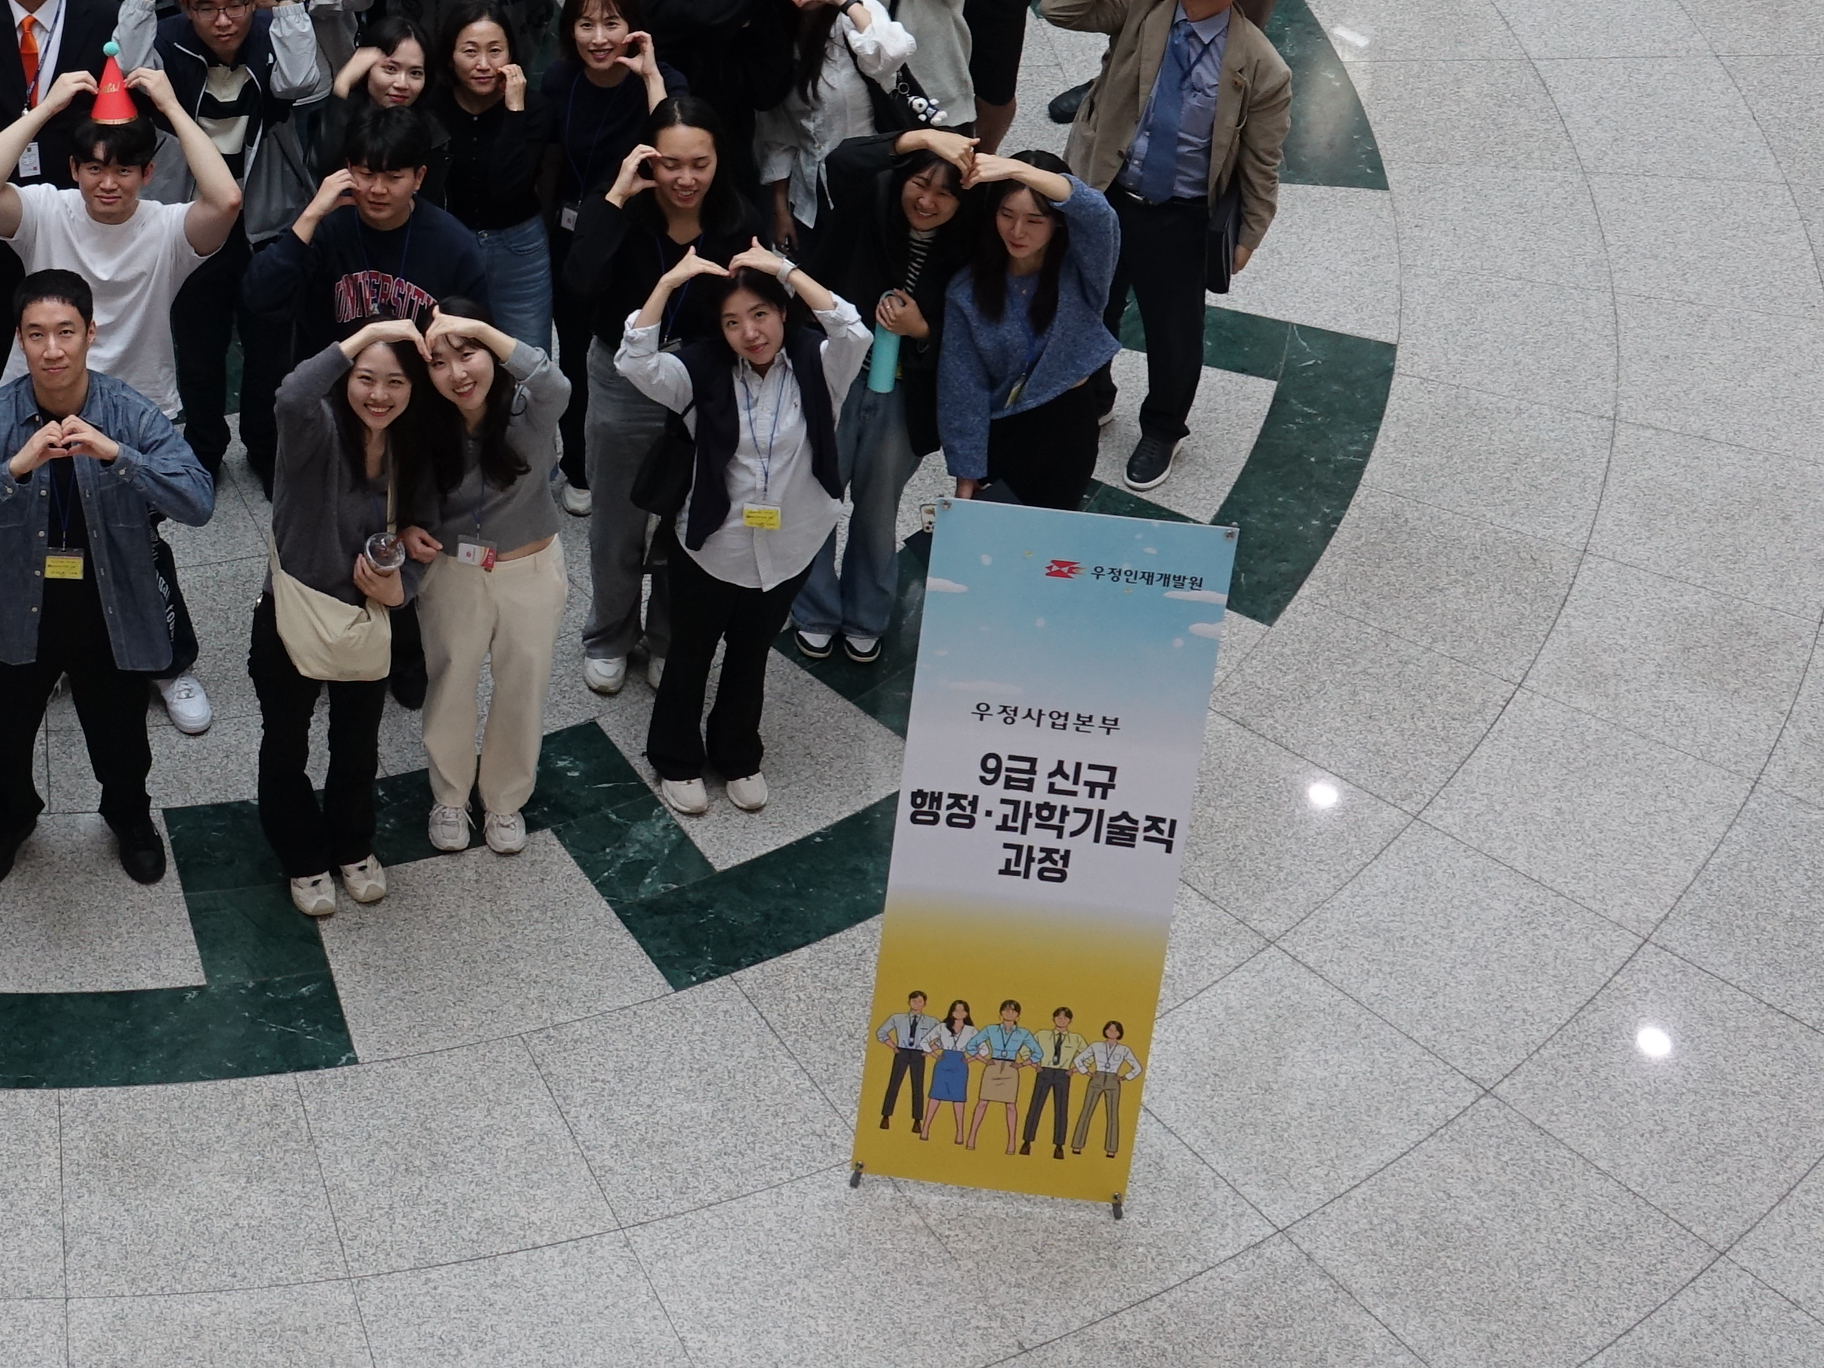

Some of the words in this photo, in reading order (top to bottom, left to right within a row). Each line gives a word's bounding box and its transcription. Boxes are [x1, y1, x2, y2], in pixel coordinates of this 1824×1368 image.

[1090, 564, 1204, 592] 우정인재개발원
[970, 701, 1122, 736] 우정사업본부
[978, 751, 1038, 793] 9급
[1046, 758, 1119, 801] 신규
[997, 842, 1071, 884] 과정
